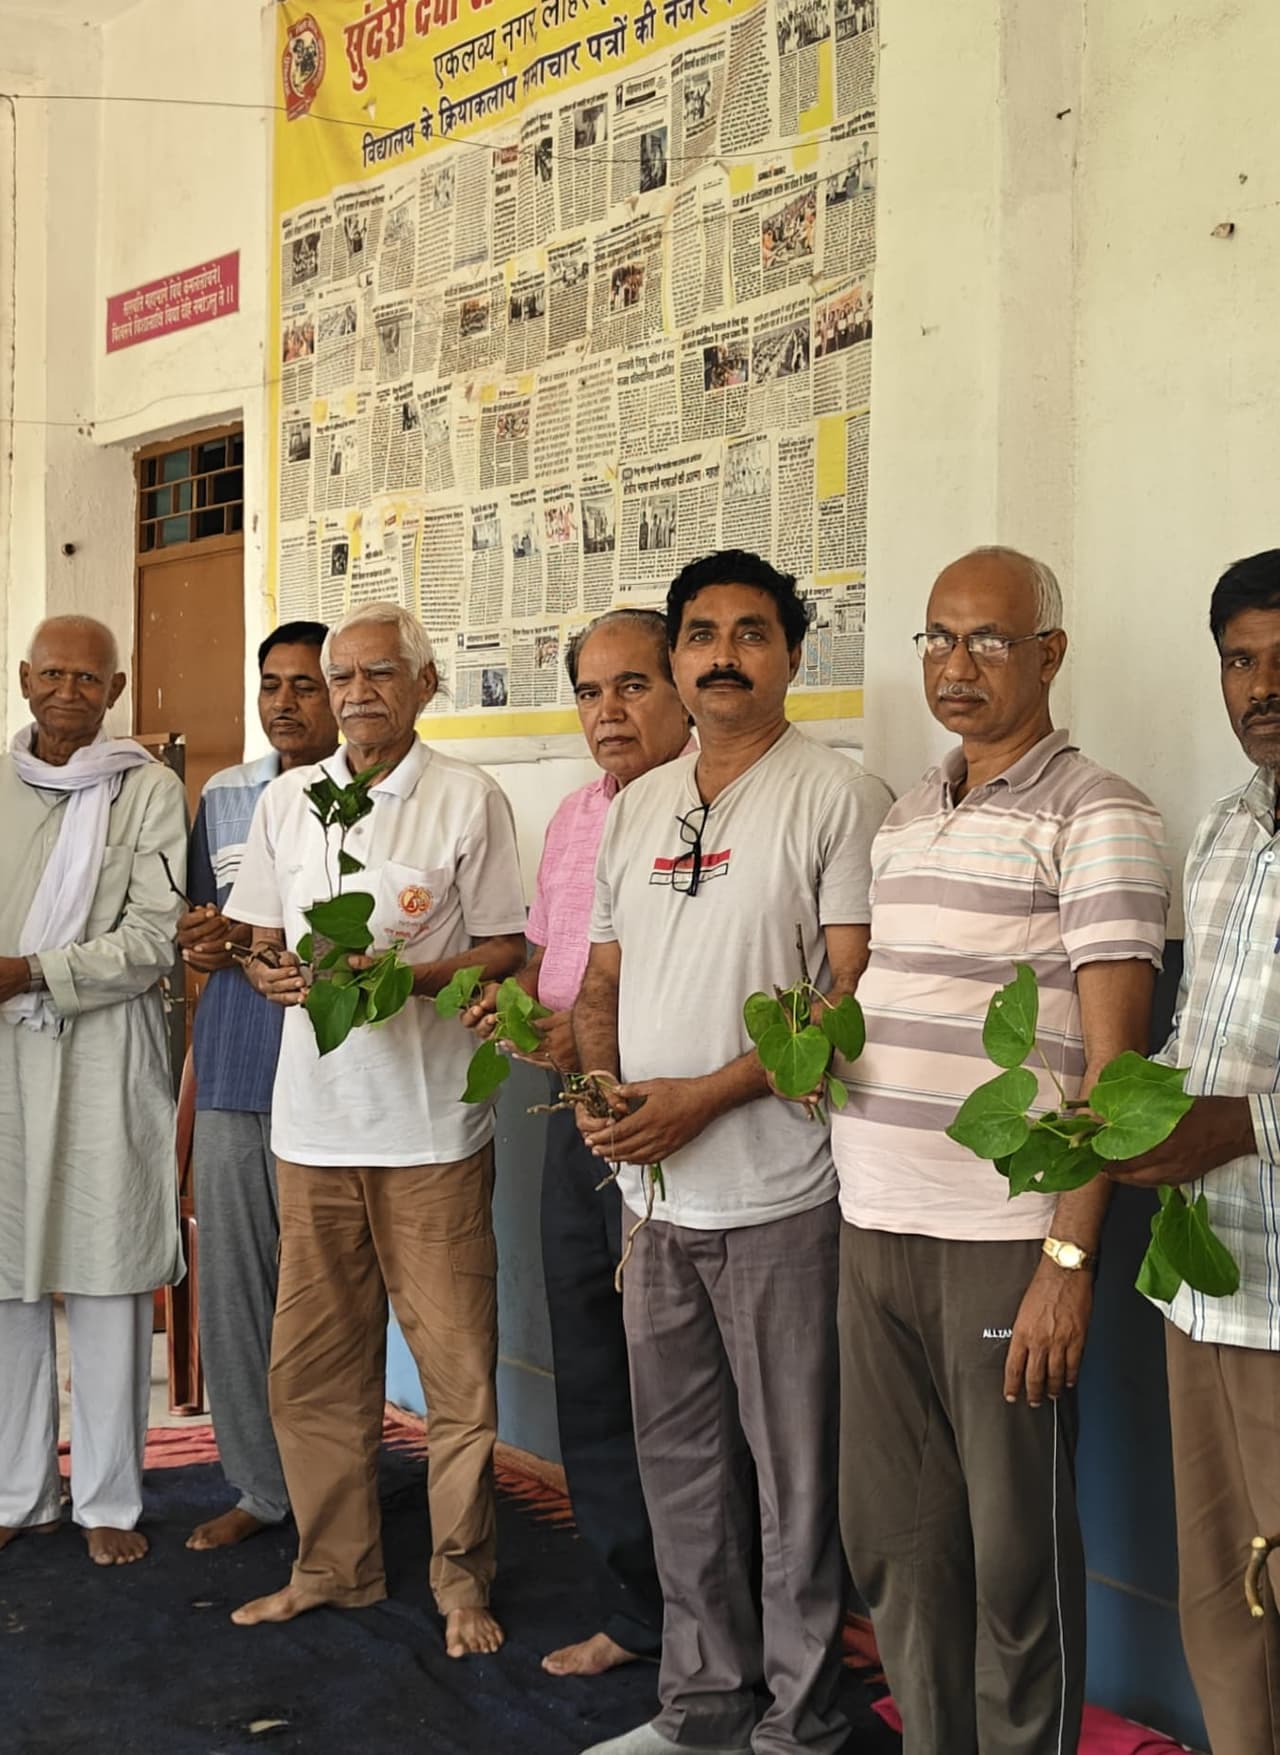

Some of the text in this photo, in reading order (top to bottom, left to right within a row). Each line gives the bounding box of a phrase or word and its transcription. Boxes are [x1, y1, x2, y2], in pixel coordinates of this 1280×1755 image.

[362, 131, 415, 168] विद्यालय
[420, 106, 434, 141] के
[438, 75, 517, 136] क्रियाकलाप
[522, 42, 581, 96] समाचार
[587, 15, 627, 62] पत्रों
[634, 0, 657, 44] की
[433, 29, 496, 89] एकलव्य
